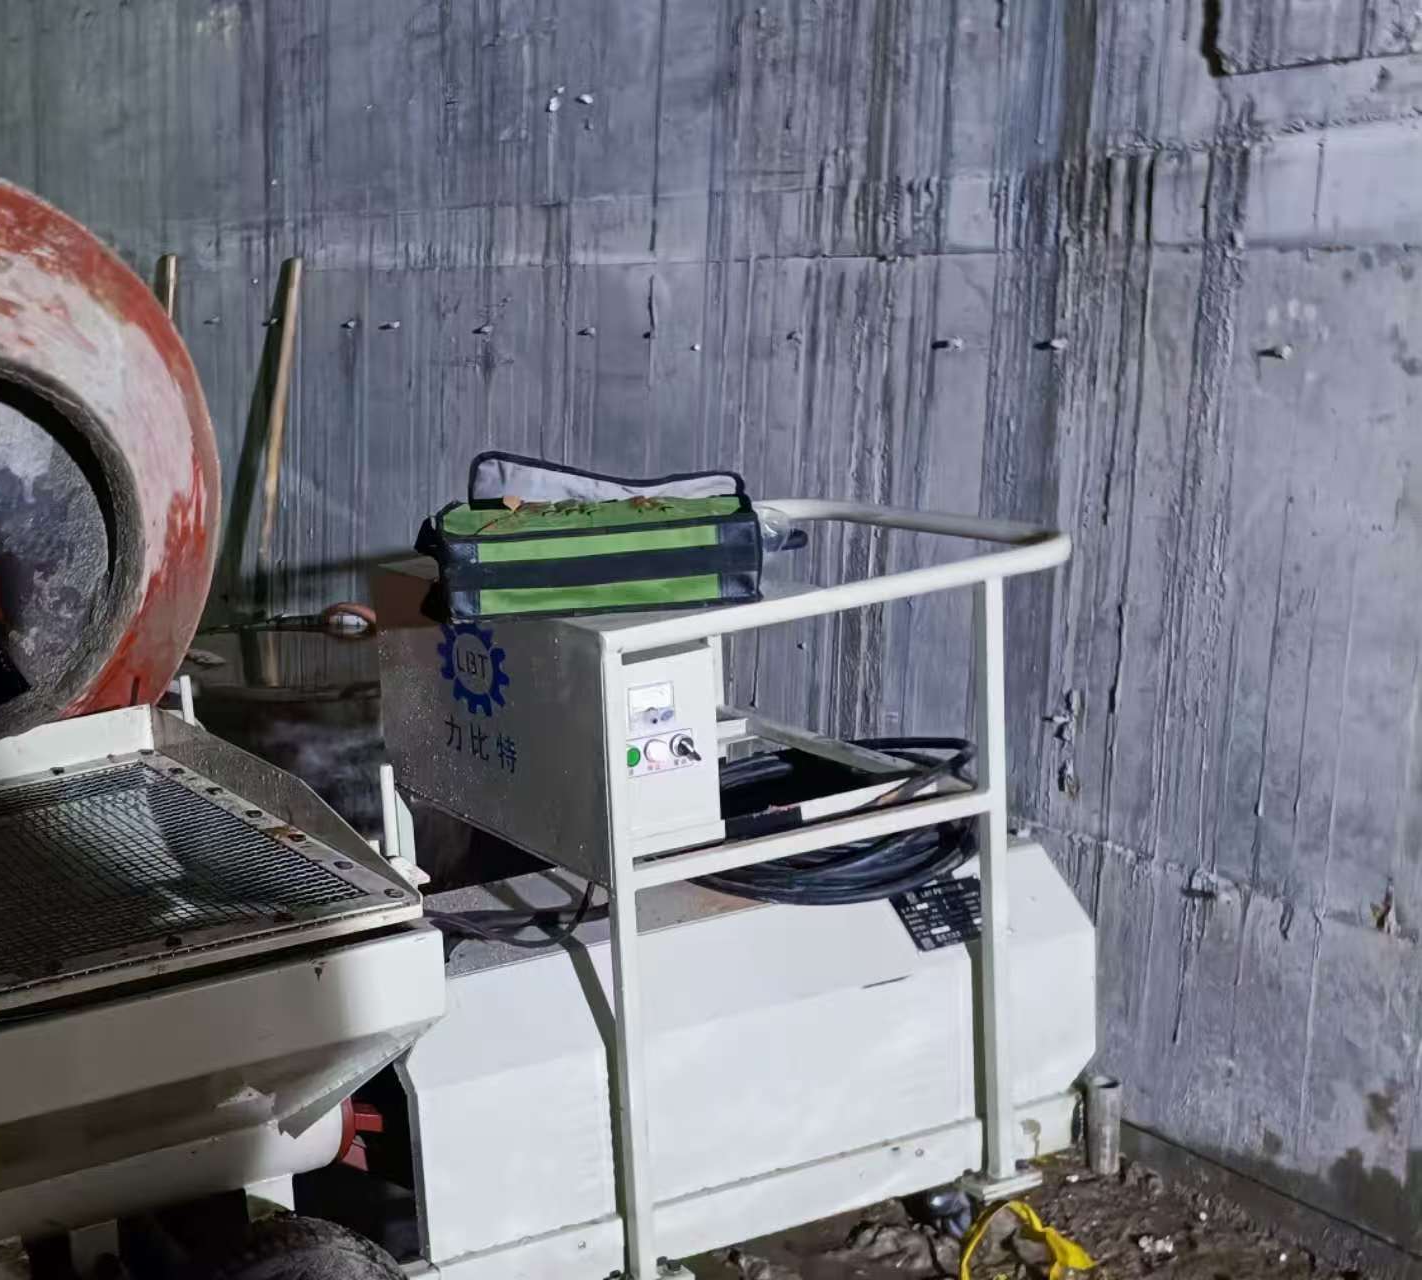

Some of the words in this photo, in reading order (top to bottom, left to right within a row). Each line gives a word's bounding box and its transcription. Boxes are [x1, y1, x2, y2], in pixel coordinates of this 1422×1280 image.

[456, 650, 488, 679] LBT
[444, 714, 518, 774] 力比特
